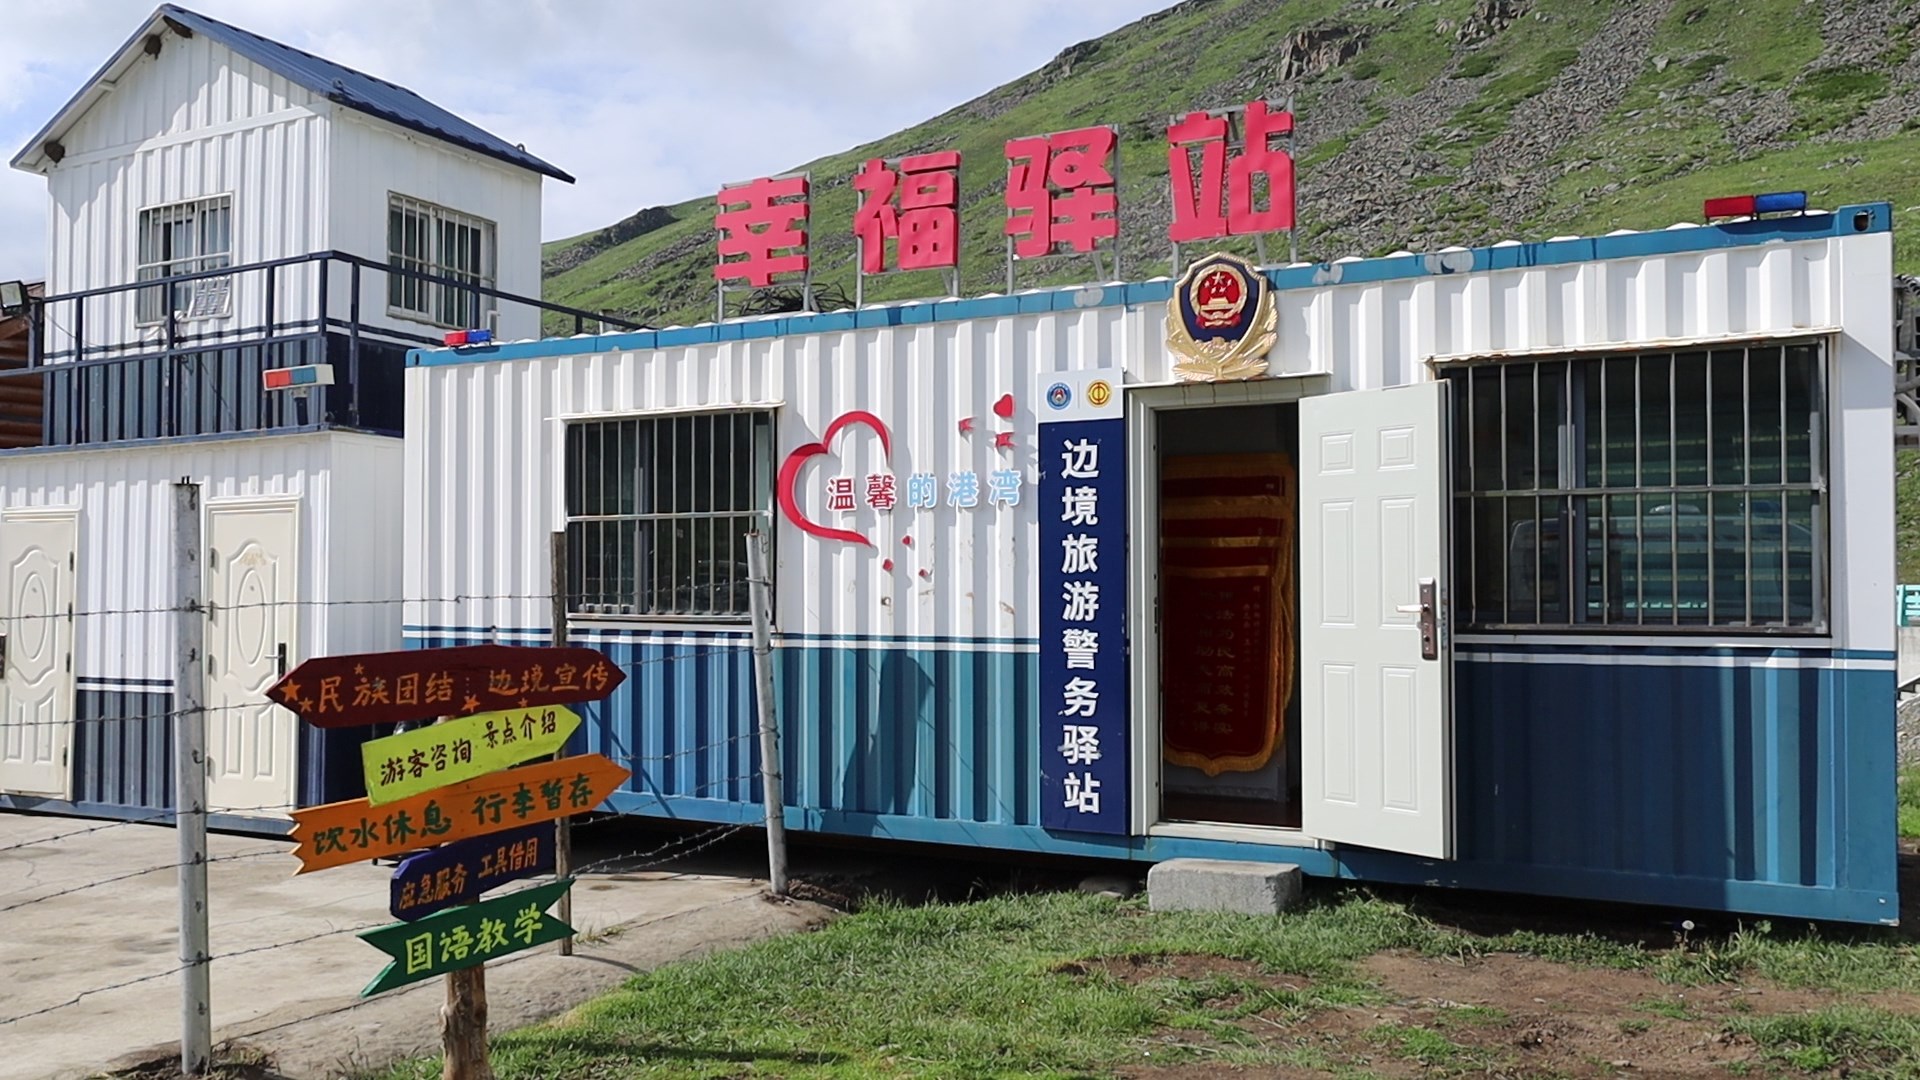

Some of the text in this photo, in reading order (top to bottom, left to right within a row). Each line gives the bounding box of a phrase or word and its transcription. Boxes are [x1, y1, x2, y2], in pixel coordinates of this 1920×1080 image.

[714, 101, 1294, 287] 幸福驿站
[826, 468, 1022, 511] 温馨的港湾
[1061, 439, 1101, 813] 边境旅游警务驿站
[318, 661, 609, 713] 民族团结 边境宣传
[380, 709, 557, 786] 游客咨询 景点介绍
[312, 771, 594, 856] 饮水休息 行李暂存
[399, 837, 539, 910] 应急服务 工具借用
[404, 902, 544, 976] 国语教学
